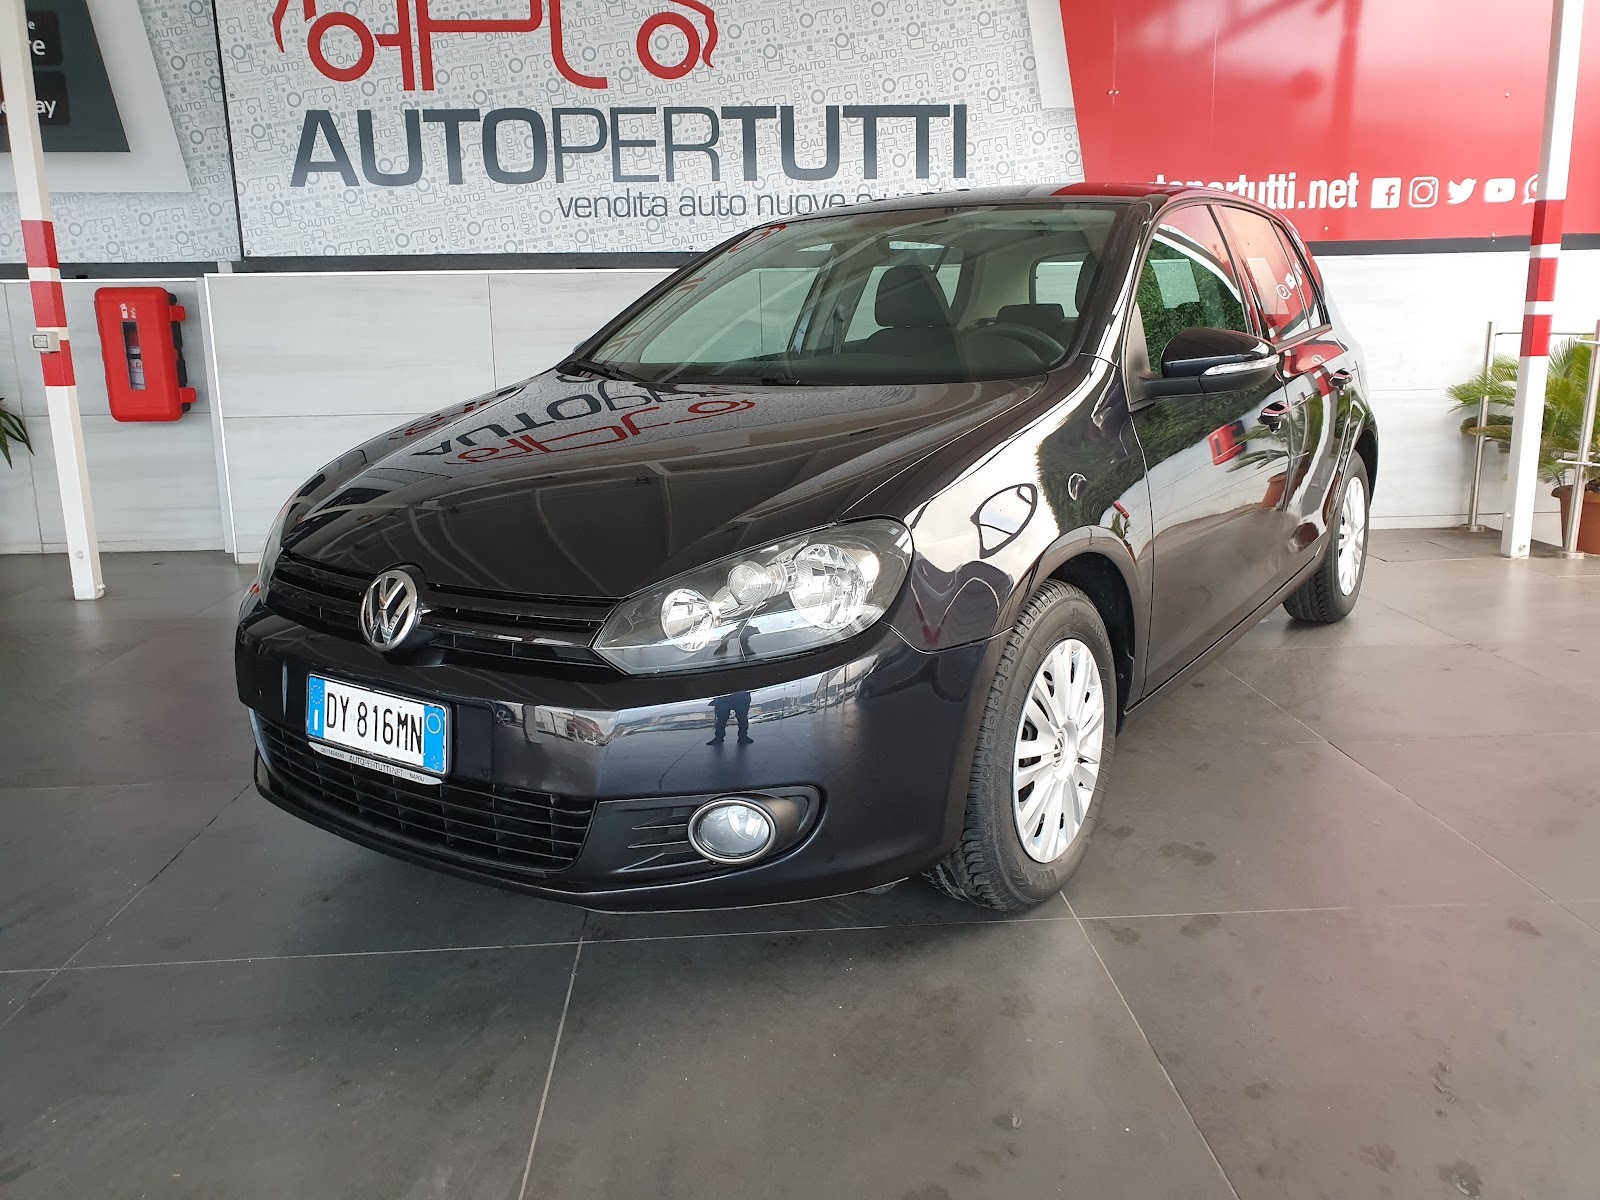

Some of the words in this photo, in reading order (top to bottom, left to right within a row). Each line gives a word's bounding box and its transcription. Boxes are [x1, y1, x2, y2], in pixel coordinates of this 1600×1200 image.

[290, 104, 967, 188] AUTOPERTUTTI
[557, 187, 669, 218] vendita
[679, 190, 747, 218] auto
[326, 692, 350, 733] DY
[357, 701, 423, 755] 816MN
